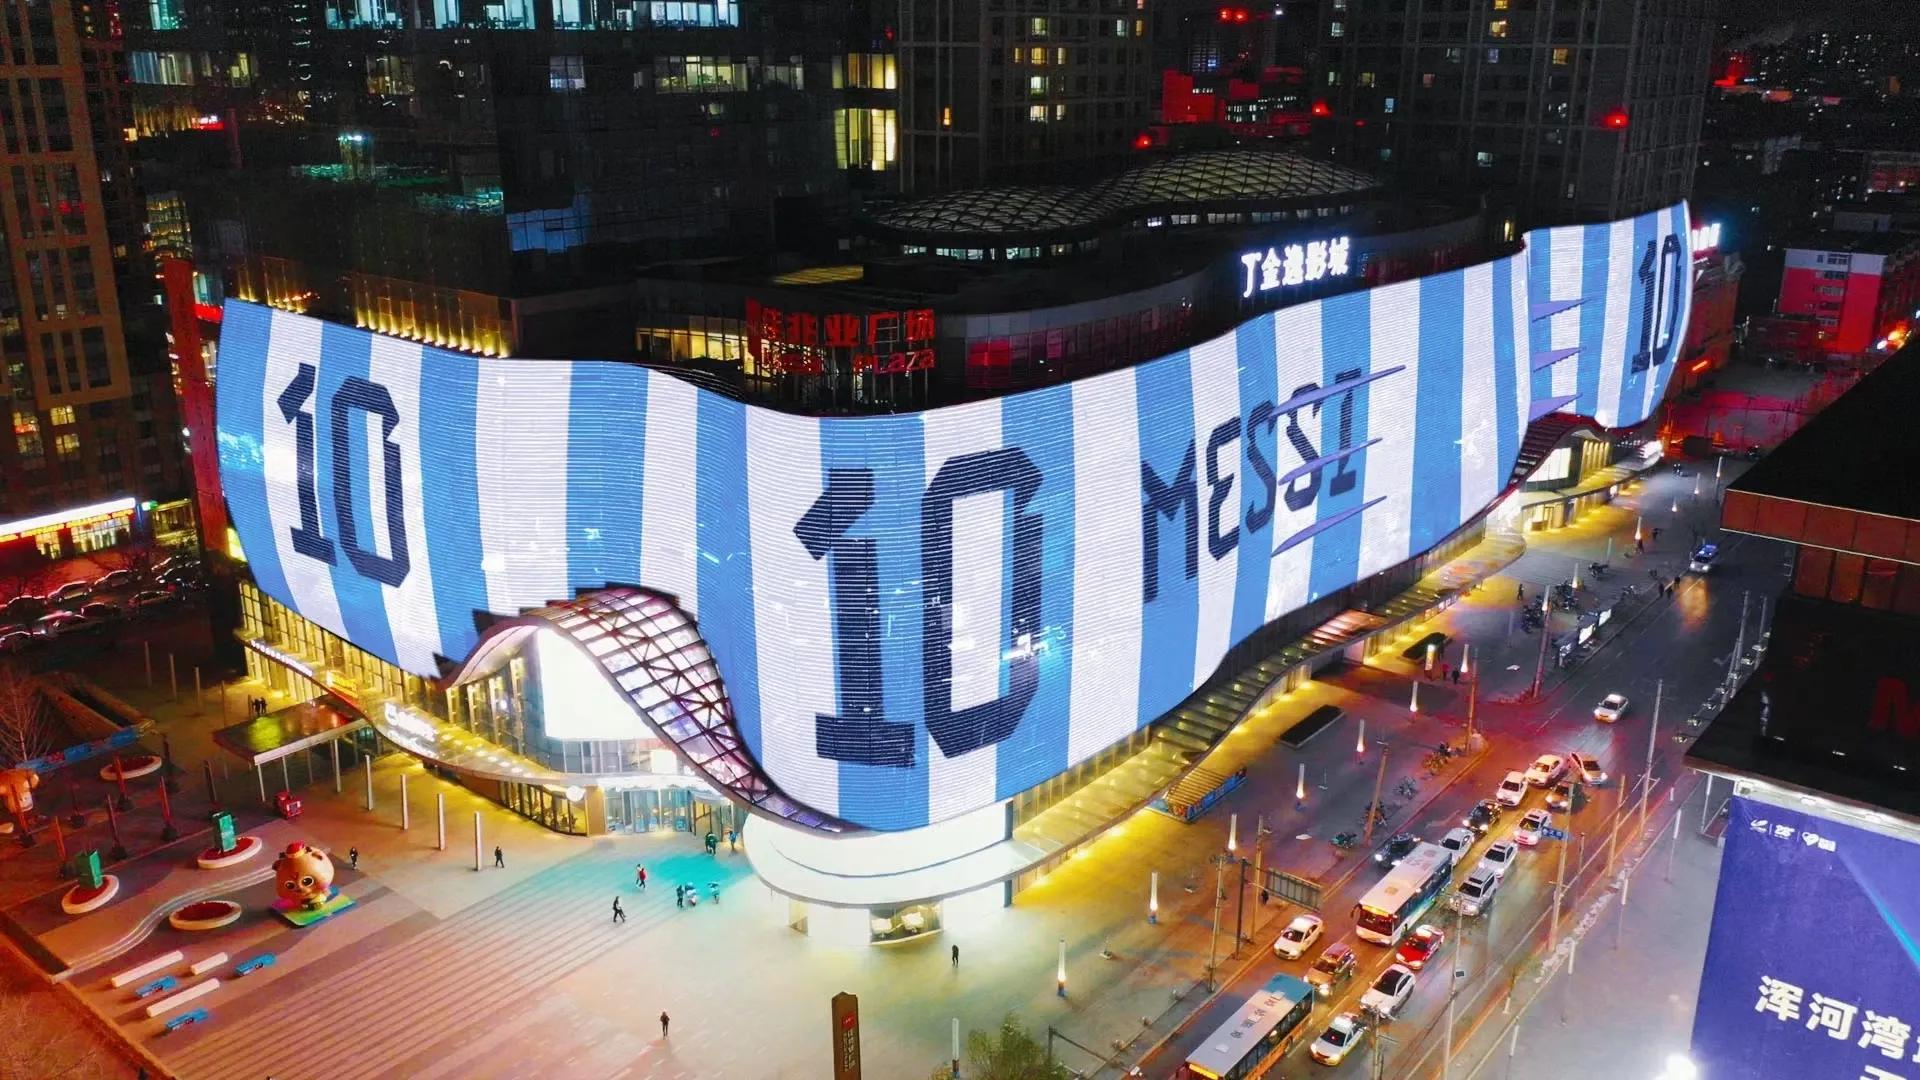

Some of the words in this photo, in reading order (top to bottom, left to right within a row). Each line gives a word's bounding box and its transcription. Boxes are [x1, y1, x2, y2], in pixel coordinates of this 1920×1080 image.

[1631, 233, 1682, 374] 10
[277, 362, 411, 589] 10
[1140, 367, 1363, 603] MESSI
[792, 446, 1045, 768] 10
[1754, 975, 1920, 1063] 浑河湾
